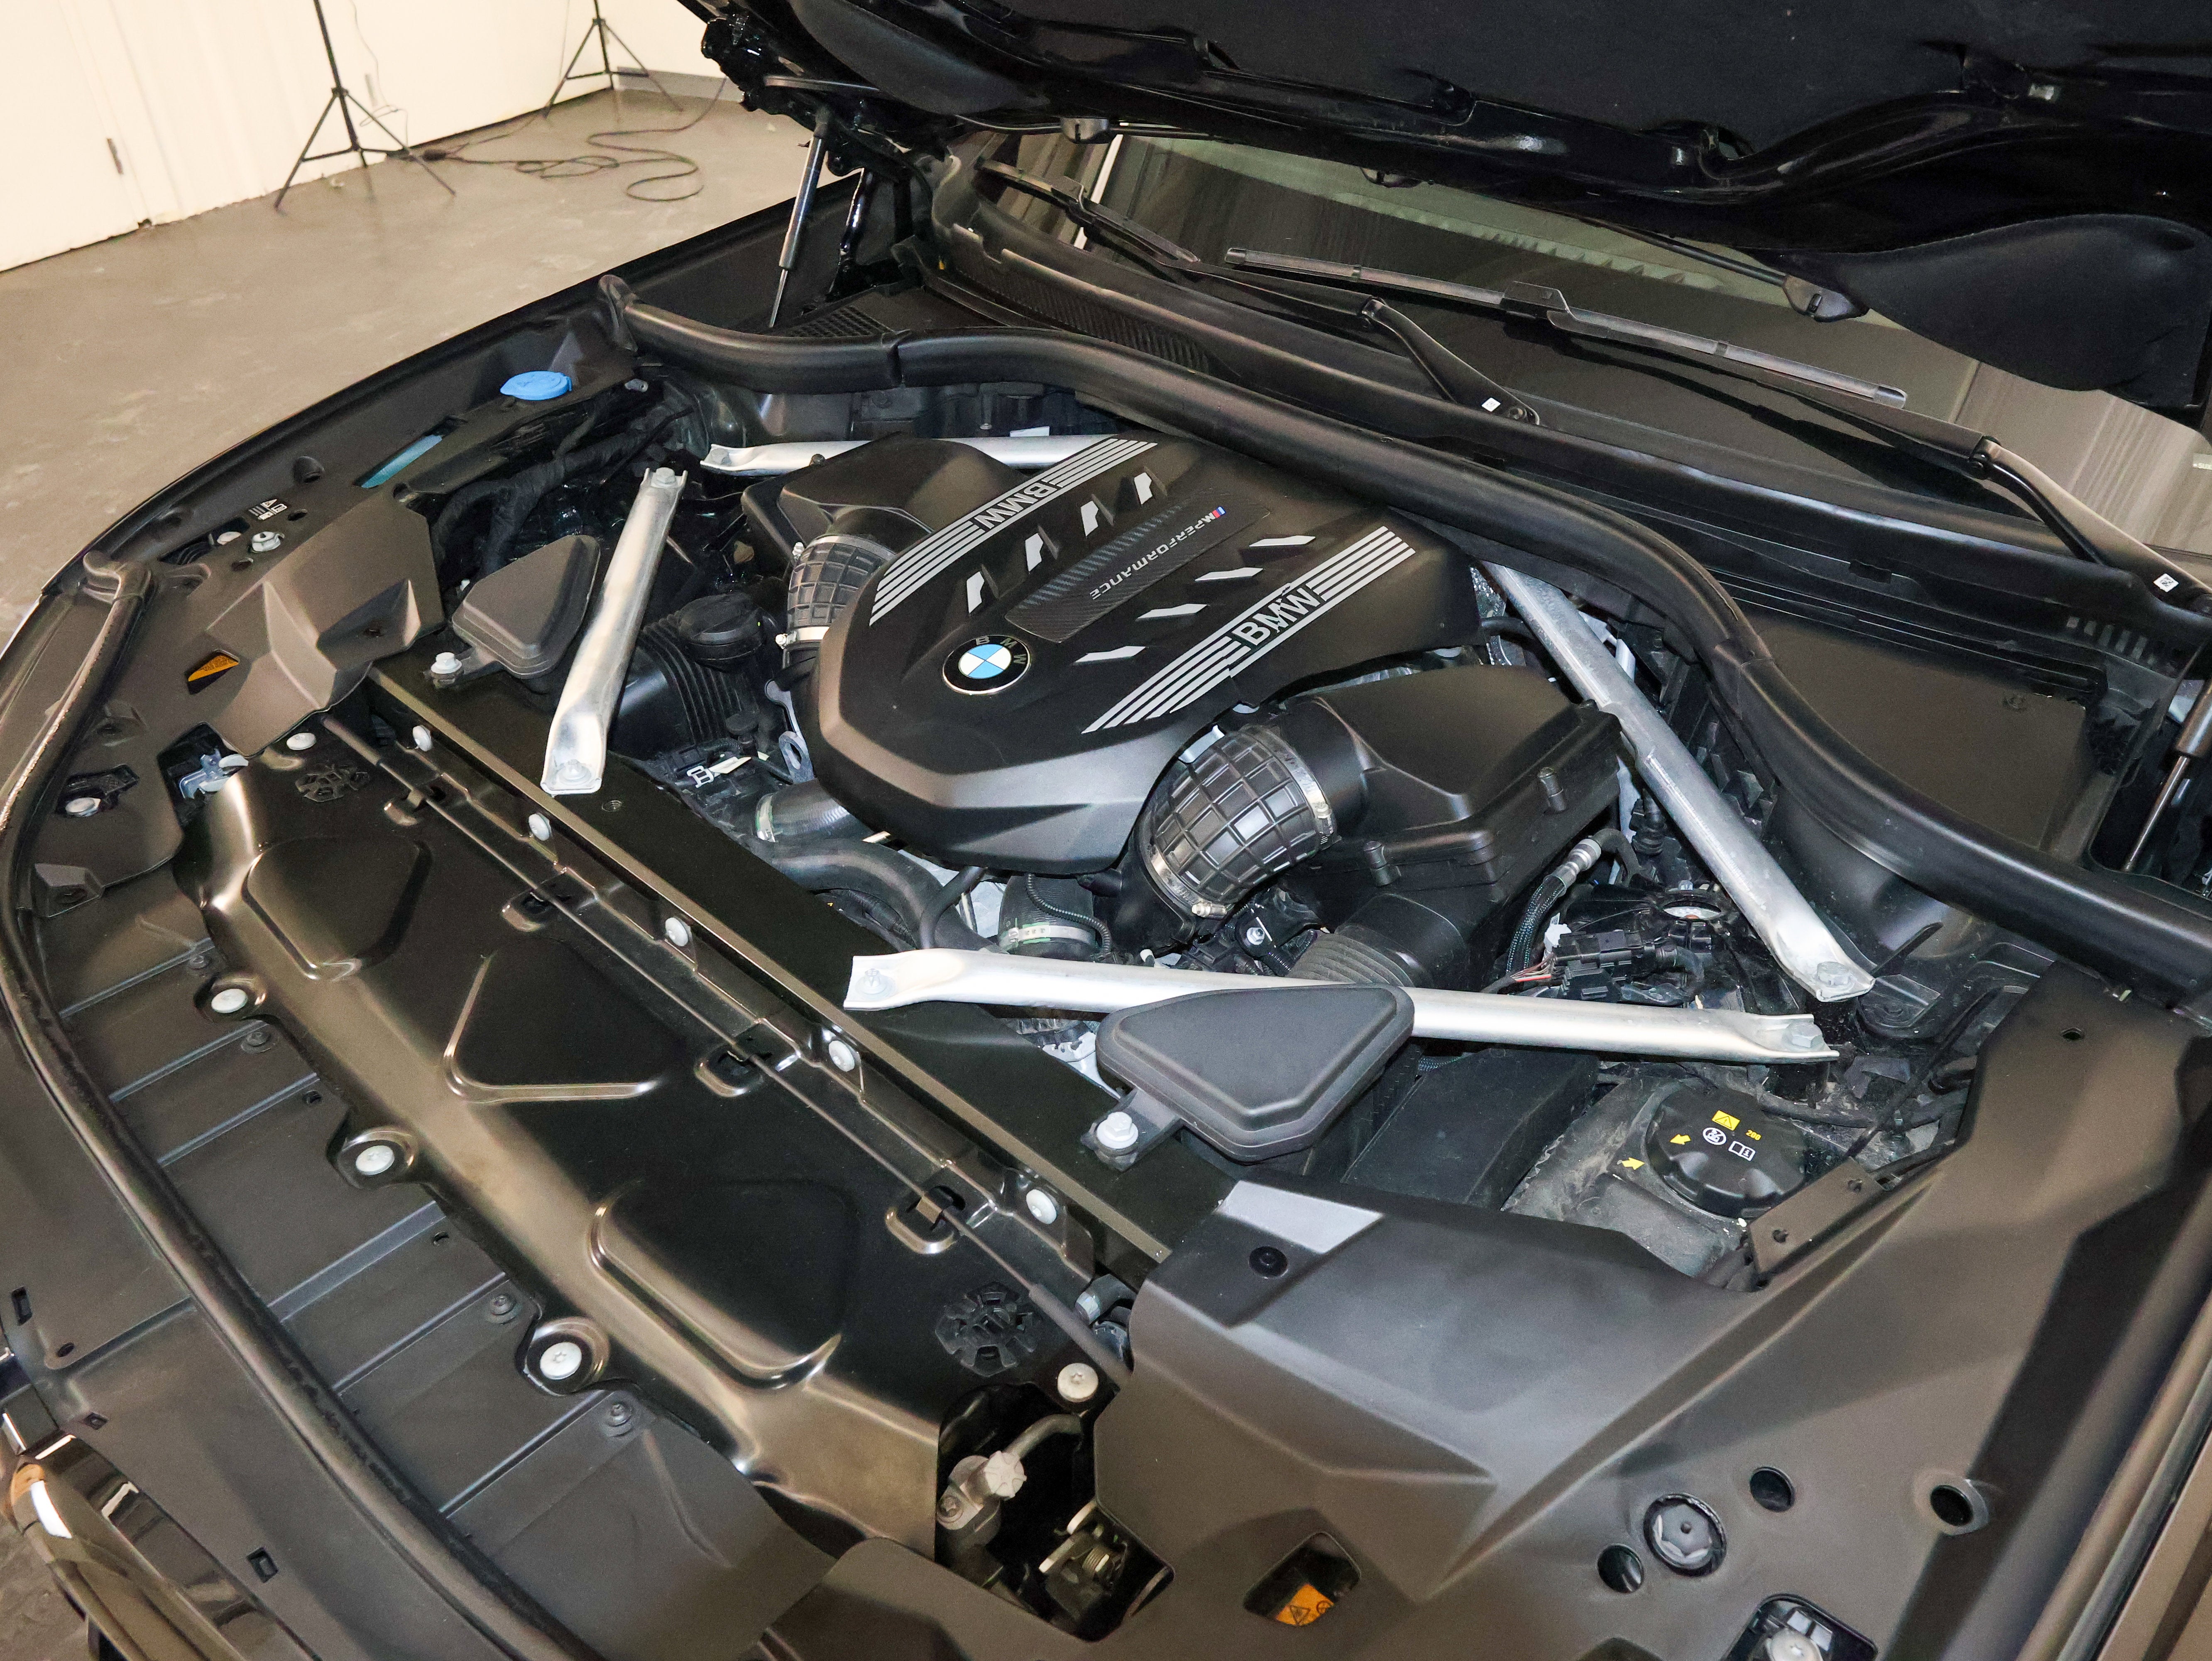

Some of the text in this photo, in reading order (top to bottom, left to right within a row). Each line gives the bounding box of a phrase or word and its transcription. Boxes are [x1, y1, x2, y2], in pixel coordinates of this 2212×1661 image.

[974, 483, 1057, 529] BMW
[1231, 588, 1321, 646] BMW
[976, 636, 1027, 664] BMW
[1746, 1129, 1762, 1141] 200
